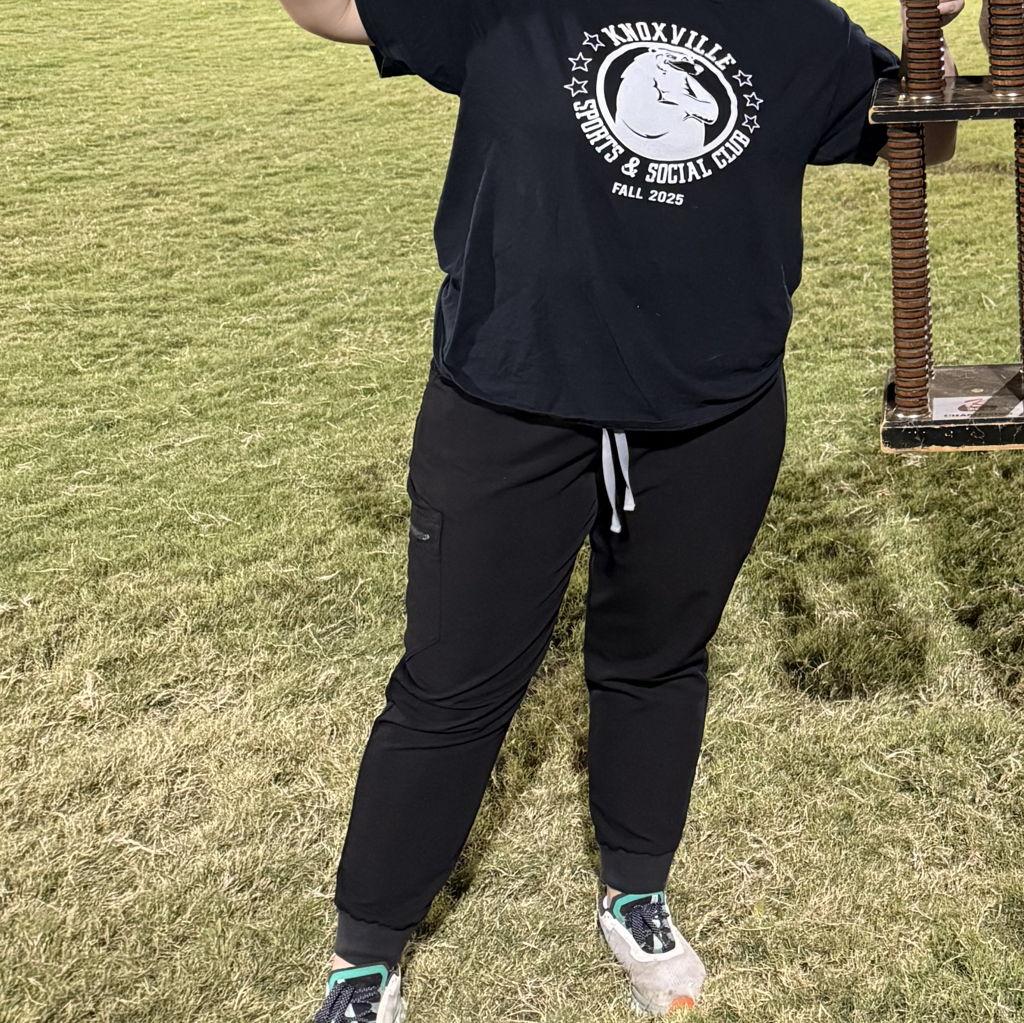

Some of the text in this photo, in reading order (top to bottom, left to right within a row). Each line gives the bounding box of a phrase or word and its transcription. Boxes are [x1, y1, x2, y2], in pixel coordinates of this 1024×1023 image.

[601, 21, 736, 71] KNOXVILLE
[573, 98, 751, 185] SPORTS & SOCIAL CLUB
[612, 182, 684, 206] FALL 2025
